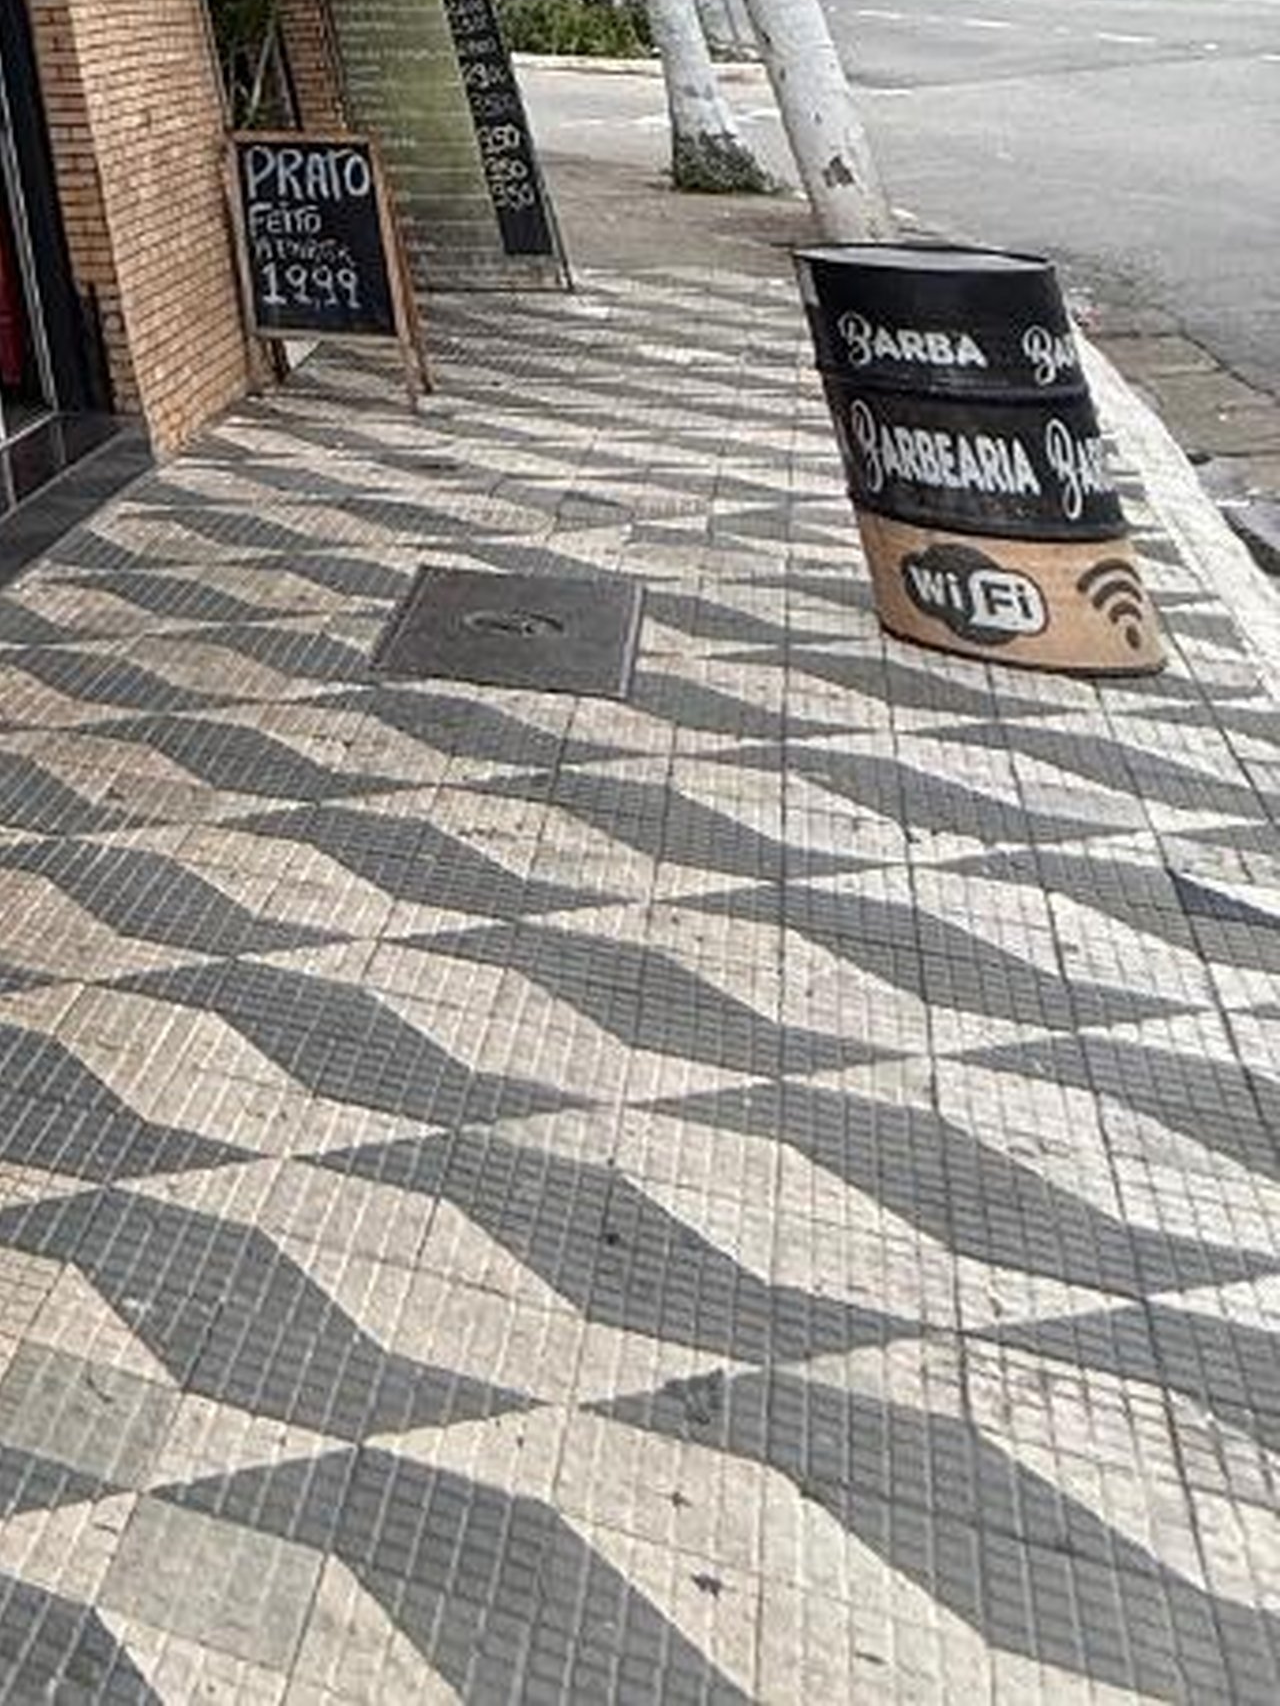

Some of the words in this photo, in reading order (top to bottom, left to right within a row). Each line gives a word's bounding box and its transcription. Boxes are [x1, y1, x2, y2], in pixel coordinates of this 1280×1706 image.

[245, 145, 371, 201] PRATO
[841, 311, 988, 367] BARBA
[852, 398, 1040, 496] BARBEARIA
